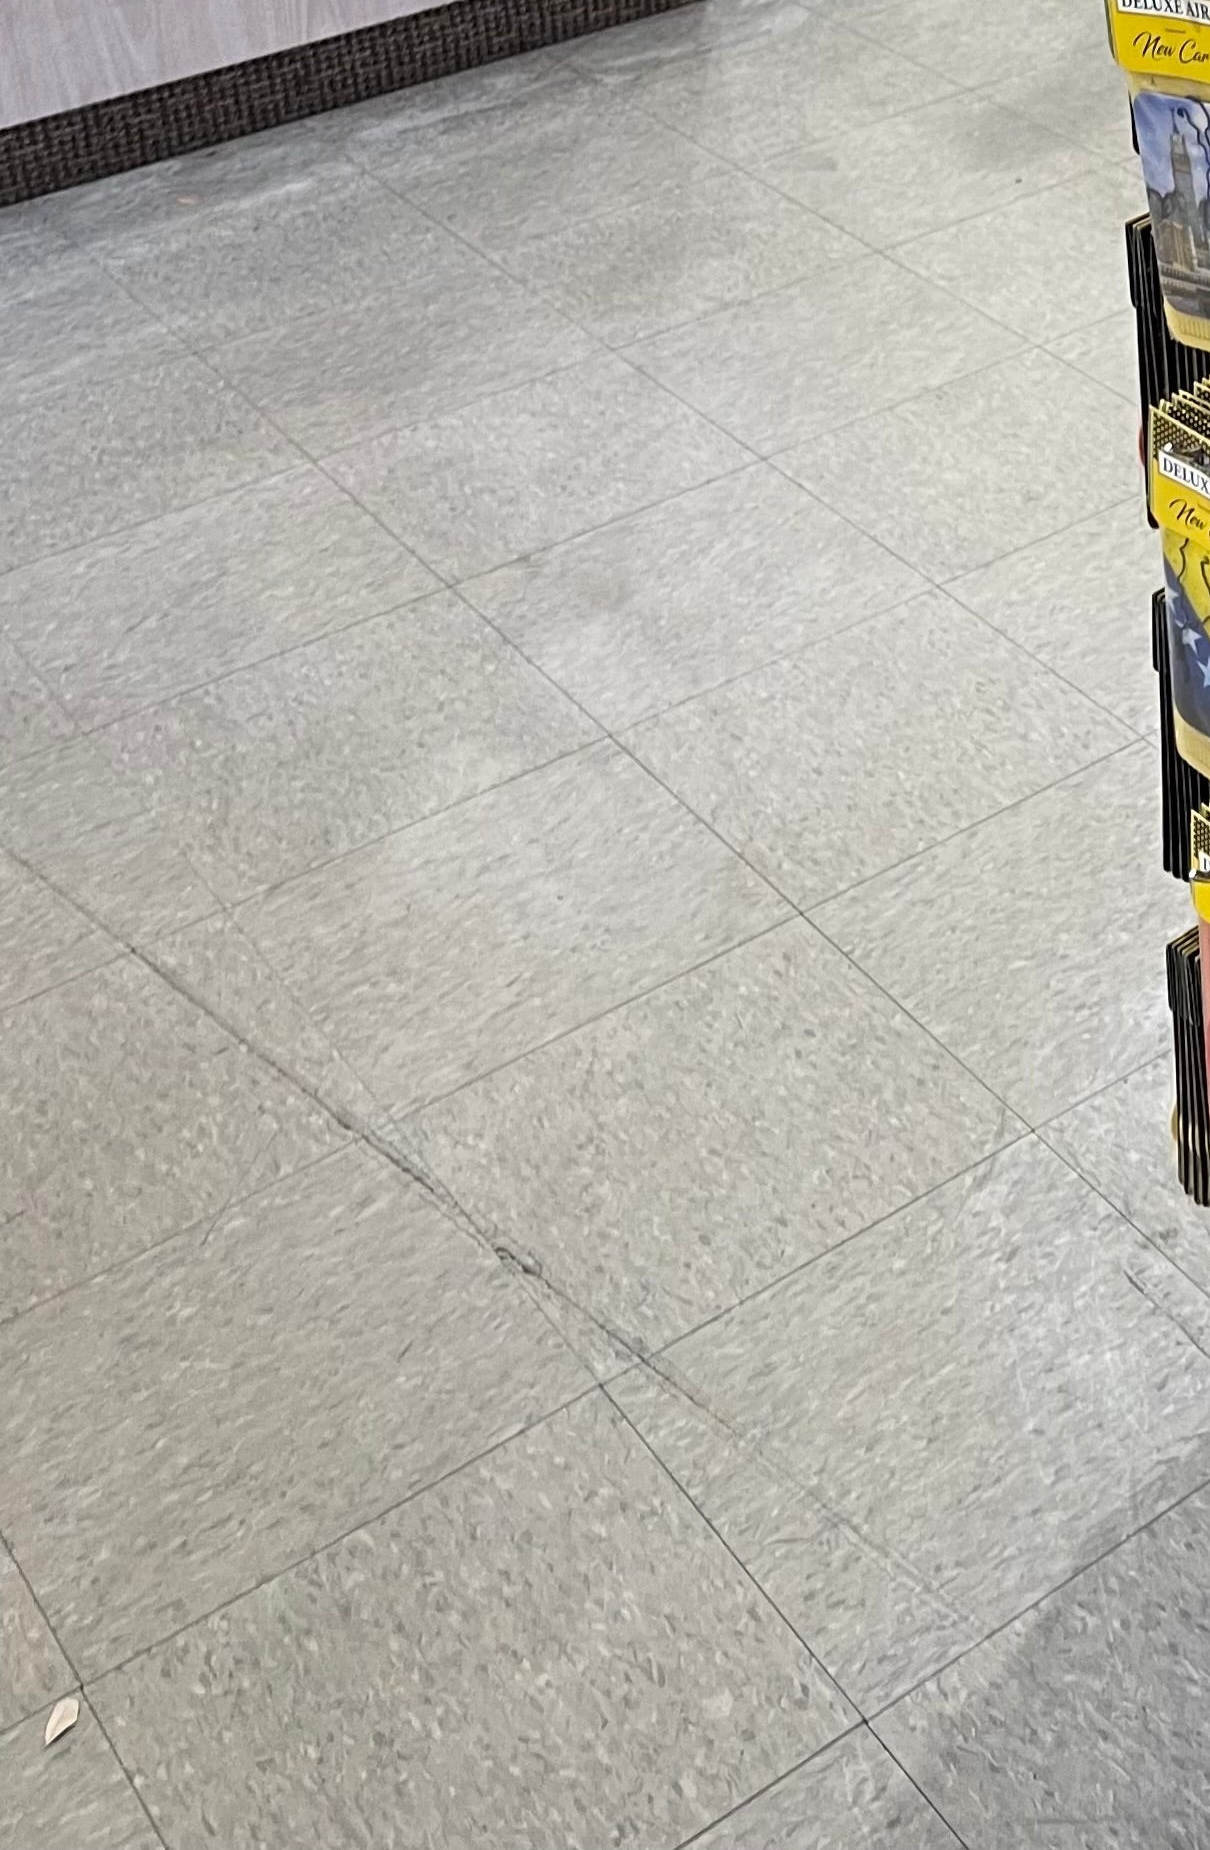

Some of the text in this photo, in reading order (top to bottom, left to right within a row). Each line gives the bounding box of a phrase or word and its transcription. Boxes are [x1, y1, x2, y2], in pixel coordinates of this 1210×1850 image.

[1186, 2, 1210, 21] AIR
[1132, 30, 1210, 64] New Car
[1169, 497, 1205, 533] New
